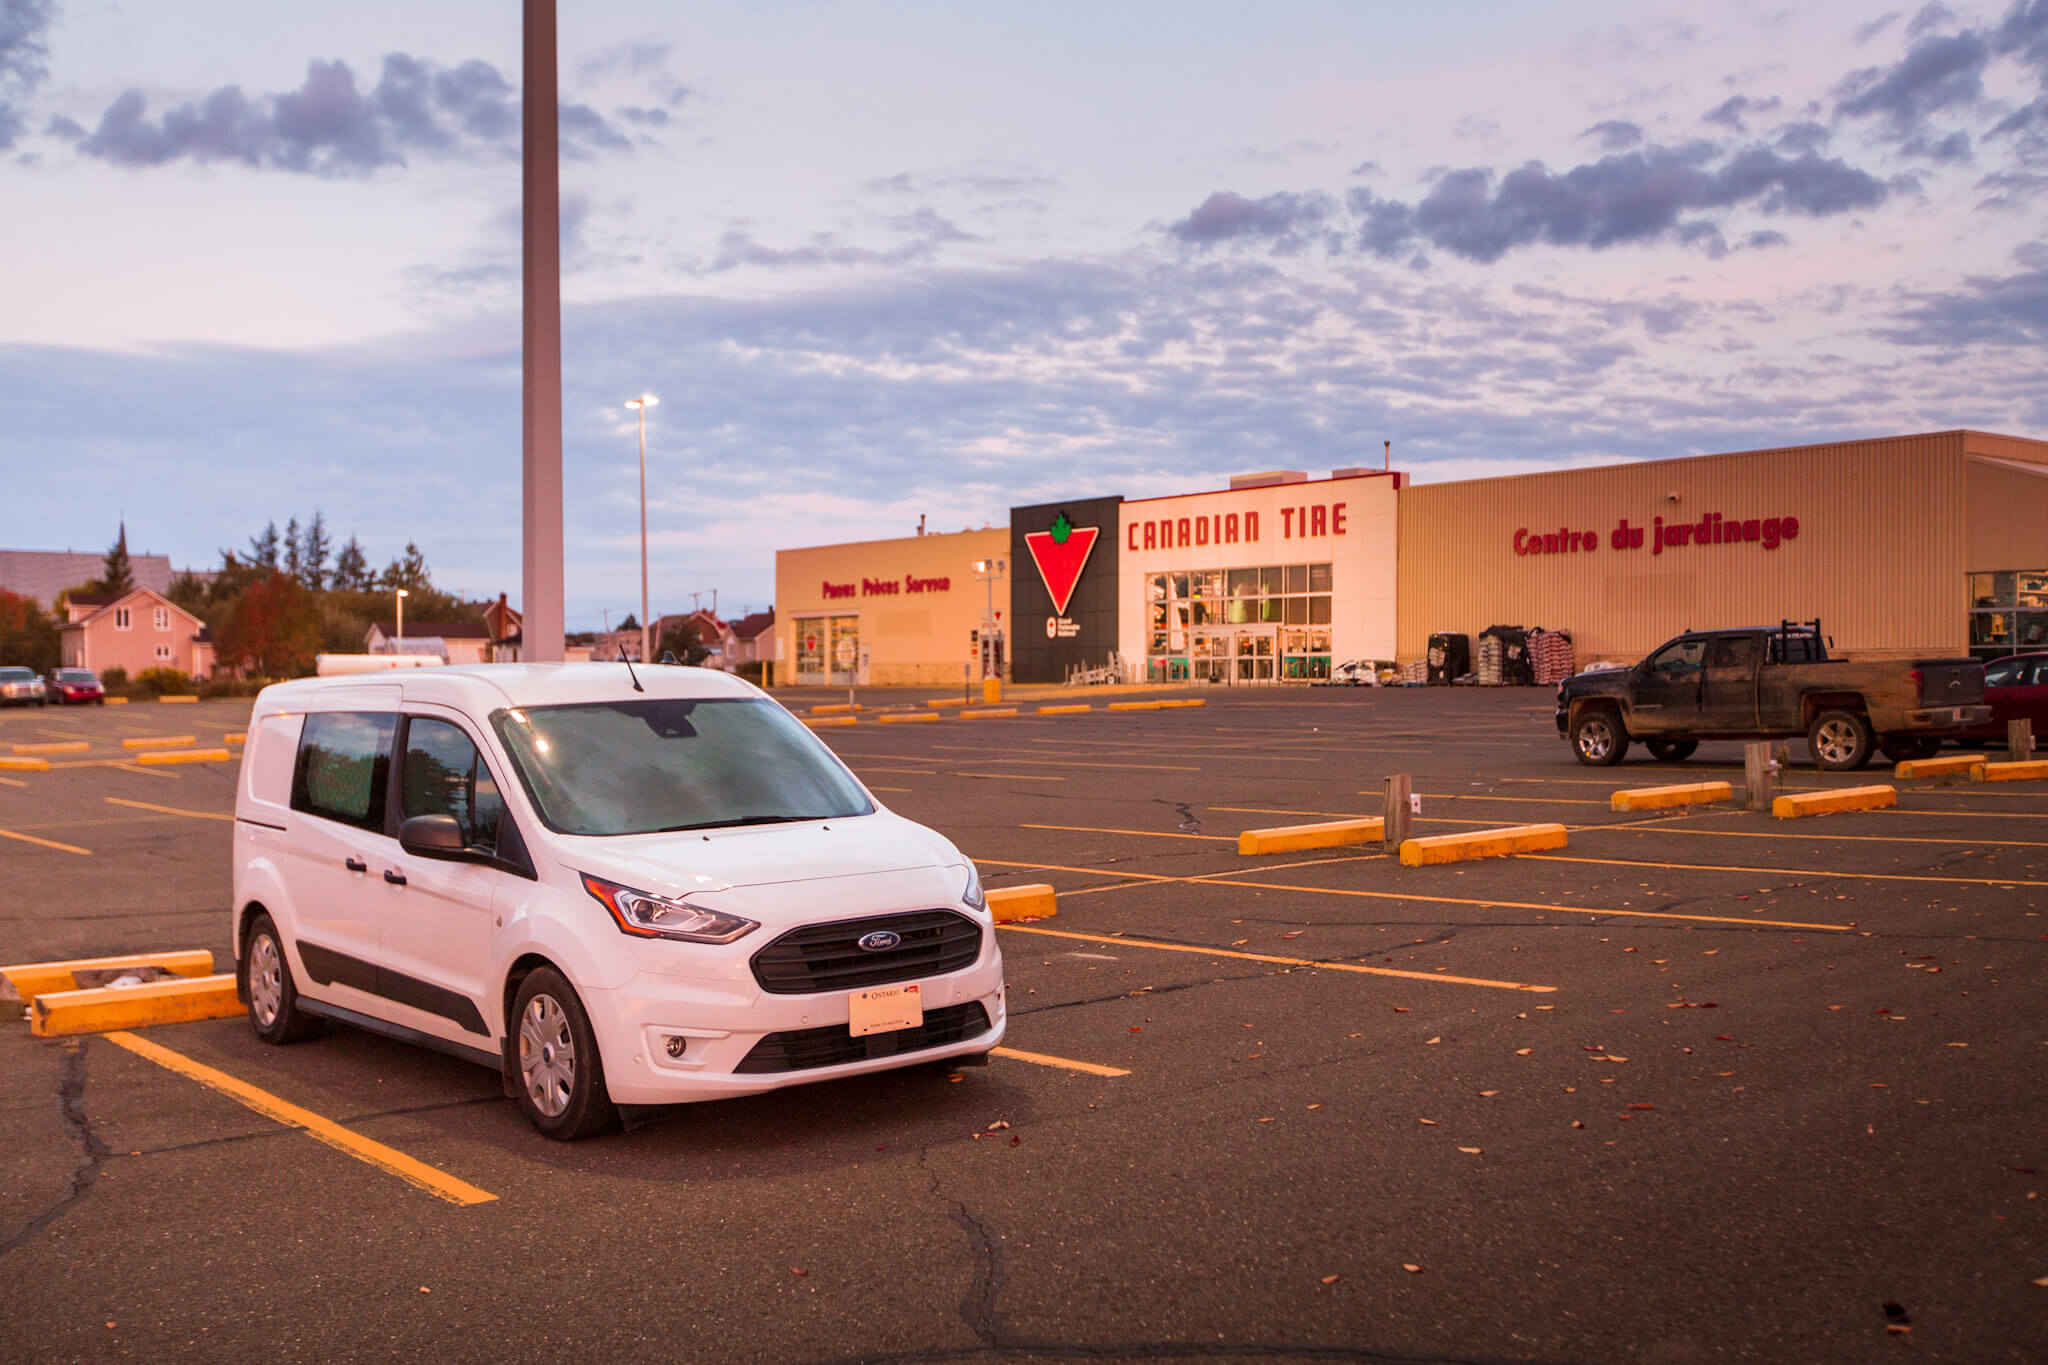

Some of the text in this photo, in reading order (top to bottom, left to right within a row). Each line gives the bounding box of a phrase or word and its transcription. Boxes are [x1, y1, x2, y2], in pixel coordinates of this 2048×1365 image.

[1128, 502, 1347, 551] CANADIAN TIRE
[1513, 512, 1800, 556] Centre du jardinage
[905, 574, 951, 594] Service
